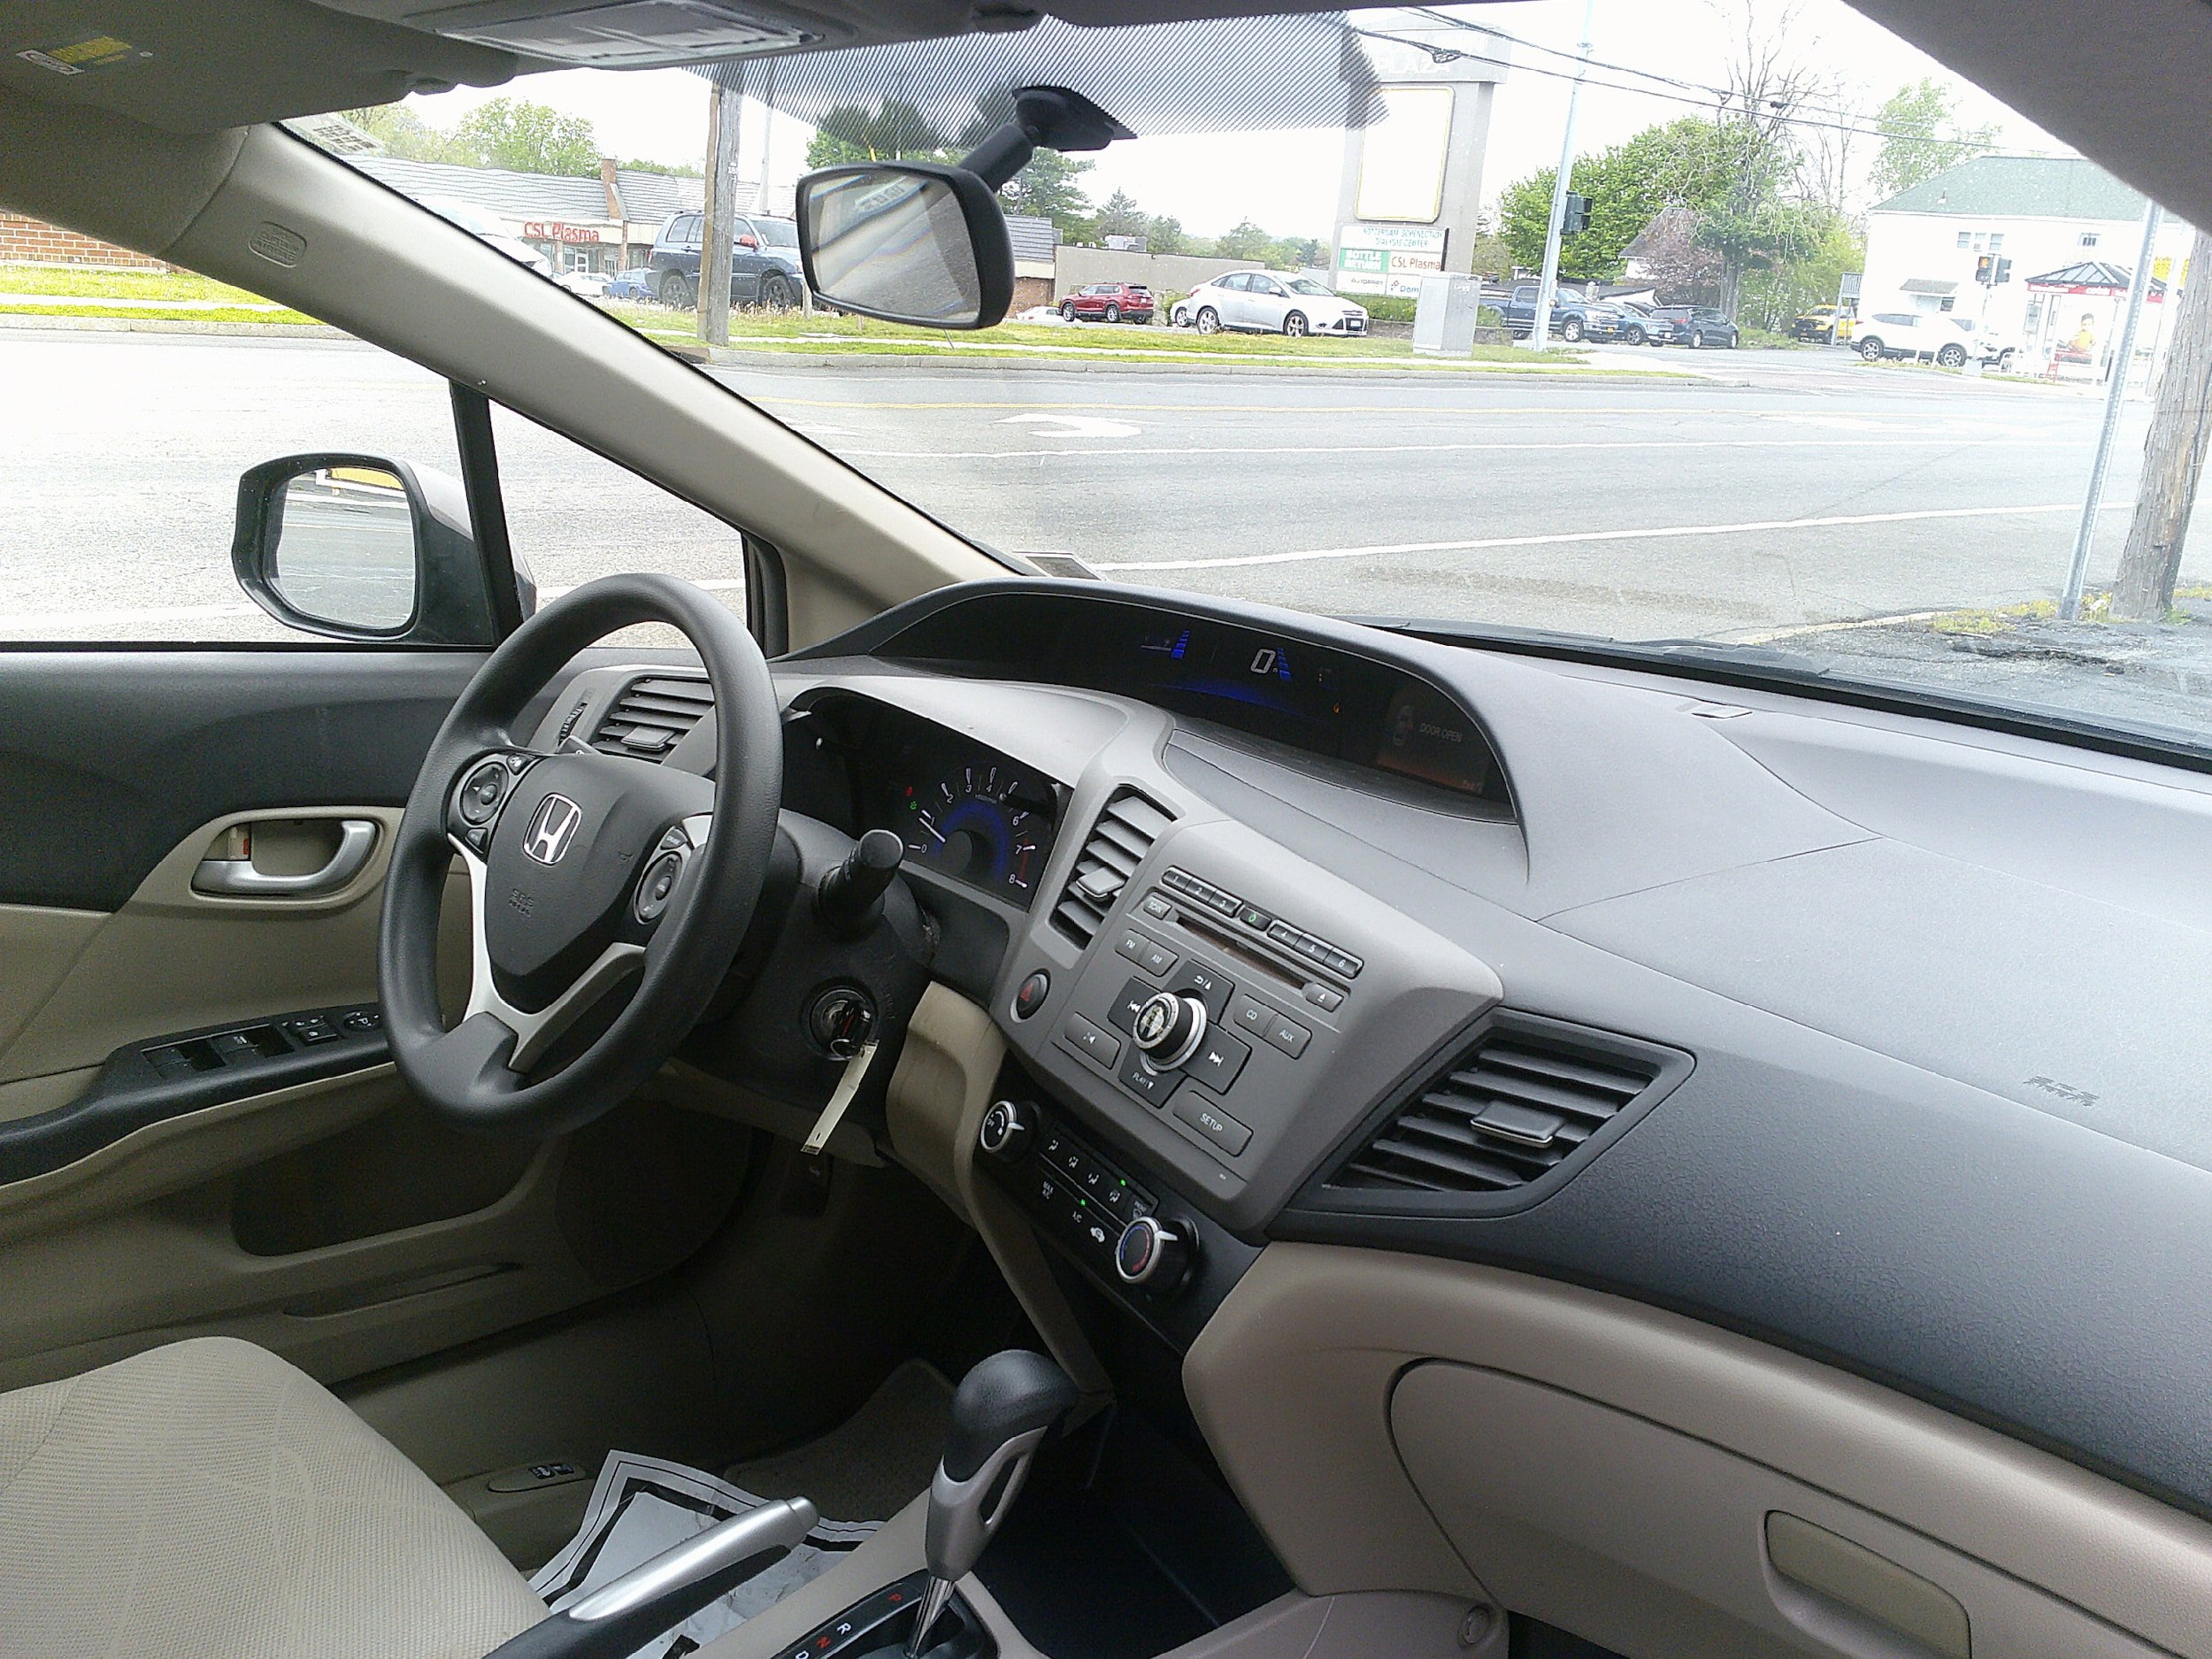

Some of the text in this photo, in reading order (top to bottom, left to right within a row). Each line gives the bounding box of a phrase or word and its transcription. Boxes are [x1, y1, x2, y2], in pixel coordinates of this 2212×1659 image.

[524, 221, 599, 242] CSL Plasma
[1391, 256, 1441, 270] CSL Plasma
[1250, 649, 1276, 673] 0
[1125, 939, 1136, 949] FM
[1150, 955, 1164, 964] AM
[1246, 1009, 1258, 1020] CD
[1279, 1028, 1295, 1043] AUX
[1200, 1113, 1223, 1132] SETUP
[837, 1623, 851, 1635] R
[817, 1637, 831, 1648] N
[795, 1650, 810, 1659] D
